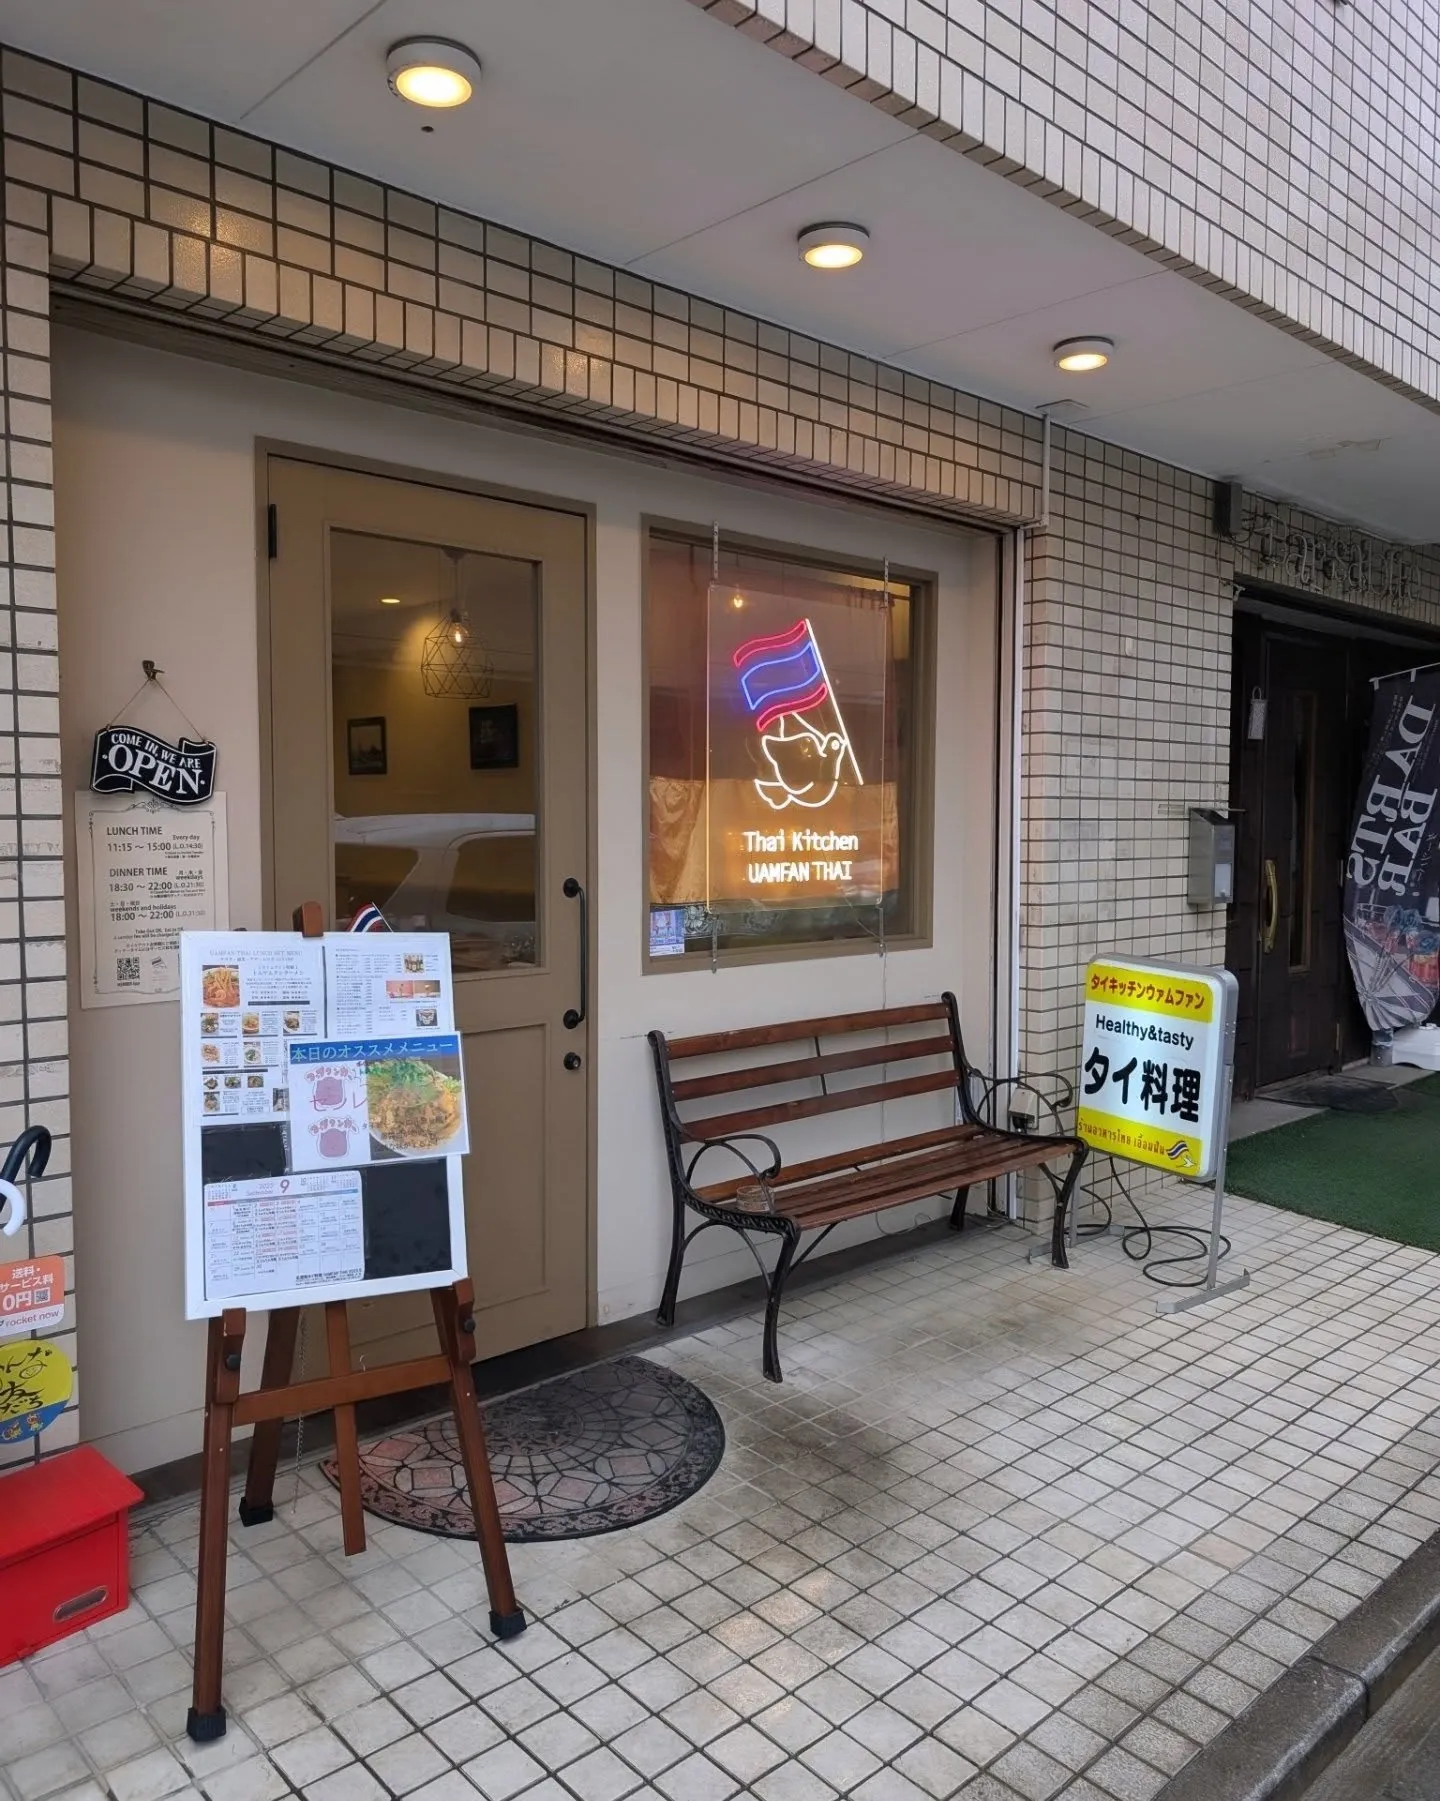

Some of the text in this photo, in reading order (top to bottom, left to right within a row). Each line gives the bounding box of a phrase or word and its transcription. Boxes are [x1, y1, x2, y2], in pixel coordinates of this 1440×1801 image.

[111, 733, 201, 769] COME IN, WE ARE
[108, 744, 203, 795] OPEN
[106, 826, 163, 836] LUNCH TIME
[742, 828, 859, 852] Thai Kitchen
[107, 842, 132, 852] 11:15
[147, 842, 171, 851] 15:00
[109, 867, 168, 877] DINNER TIME
[748, 861, 853, 883] UAMFAN THAI
[109, 883, 134, 892] 18:30
[148, 881, 173, 891] 22:00
[111, 912, 135, 922] 18:00
[149, 910, 174, 920] 22:00
[152, 903, 177, 911] holidays
[1090, 973, 1205, 1010] タイキッチンウァムファン
[1095, 1013, 1194, 1051] Healthy&tasty
[291, 1042, 453, 1061] 本日のオススメメニュー
[1084, 1046, 1201, 1123] タイ料理
[279, 1179, 290, 1193] 9
[0, 1273, 53, 1292] サービス料
[3, 1290, 32, 1311] 0円
[5, 1310, 59, 1327] rocket now
